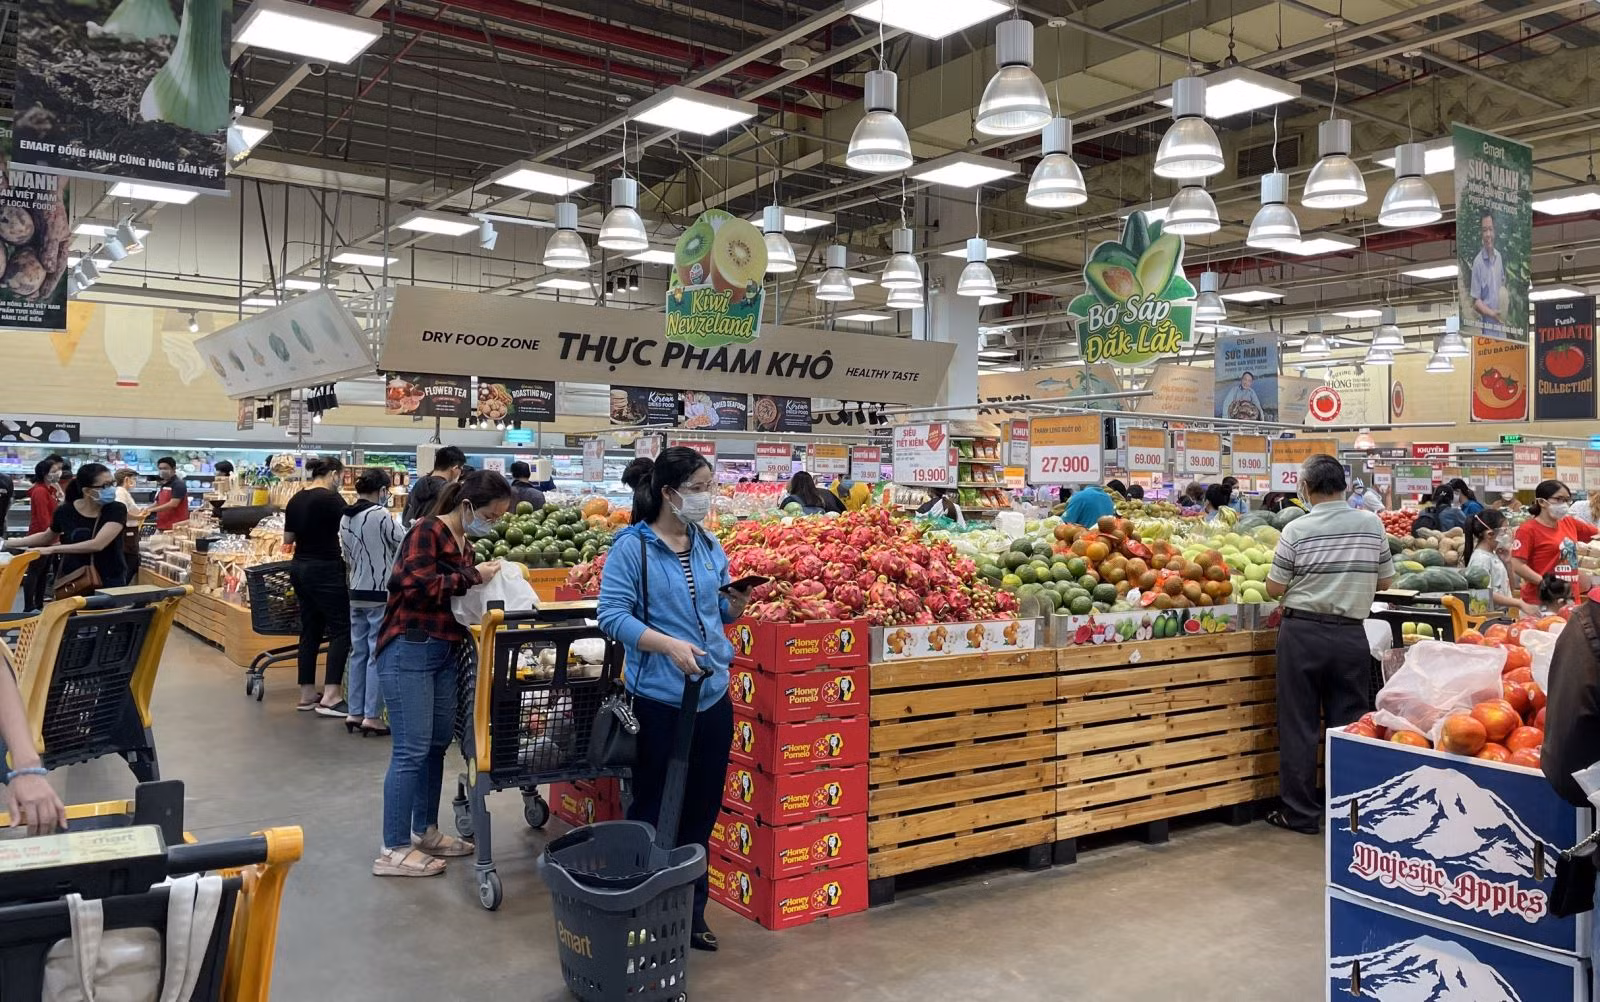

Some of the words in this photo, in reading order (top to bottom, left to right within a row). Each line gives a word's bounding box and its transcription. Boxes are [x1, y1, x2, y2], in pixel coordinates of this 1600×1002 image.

[1483, 142, 1505, 159] emart
[20, 139, 55, 154] EMART
[58, 143, 86, 158] ĐỒNG
[88, 148, 117, 163] HÀNH
[118, 153, 146, 167] CÙNG
[148, 156, 175, 172] NÔNG
[176, 161, 197, 176] DÂN
[198, 166, 219, 180] VIỆT
[1467, 157, 1490, 182] SỨC
[8, 170, 58, 191] MẠNH
[15, 189, 34, 200] VIỆT
[37, 192, 57, 202] NAM
[7, 199, 31, 208] LOCAL
[32, 202, 57, 212] FOODS
[691, 288, 733, 314] Kiwi
[1089, 301, 1120, 333] Bơ
[1123, 293, 1170, 327] Sáp
[666, 311, 755, 338] Newzeland
[1555, 316, 1576, 326] Fresh
[1538, 324, 1593, 343] TOMATO
[421, 330, 454, 344] DRY
[454, 333, 499, 348] FOOD
[500, 337, 541, 351] ZONE
[1086, 326, 1134, 363] Đắk
[1136, 320, 1183, 354] Lắk
[557, 331, 658, 372] THỰC
[764, 349, 834, 380] KHÔ
[1478, 348, 1493, 356] SIÊU
[845, 366, 889, 379] HEALTHY
[890, 370, 920, 382] TASTE
[424, 385, 453, 397] FLOWER
[454, 387, 468, 398] TEA
[1537, 377, 1593, 395] COLLECTION
[511, 388, 540, 399] ROASTING
[540, 391, 553, 401] NUT
[902, 427, 917, 438] SIÊU
[896, 438, 908, 449] TIẾT
[908, 438, 924, 449] KIỆM
[1041, 454, 1090, 473] 27.900
[1134, 453, 1161, 465] 69.000
[1190, 455, 1215, 467] 39.000
[1237, 457, 1262, 469] 19.900
[912, 468, 947, 482] 19.900
[789, 645, 820, 655] Pomelo
[794, 638, 820, 649] Honey
[794, 687, 819, 697] Honey
[789, 694, 819, 704] Pomelo
[788, 743, 811, 753] Honey
[783, 750, 811, 760] Pomelo
[787, 793, 811, 804] Honey
[783, 800, 810, 811] Pomelo
[786, 846, 811, 857] Honey
[782, 853, 809, 865] Pomelo
[1351, 844, 1445, 890] Majestic
[1449, 874, 1543, 914] Apples
[786, 895, 810, 907] Honey
[782, 903, 809, 915] Pomelo
[557, 920, 593, 959] emart
